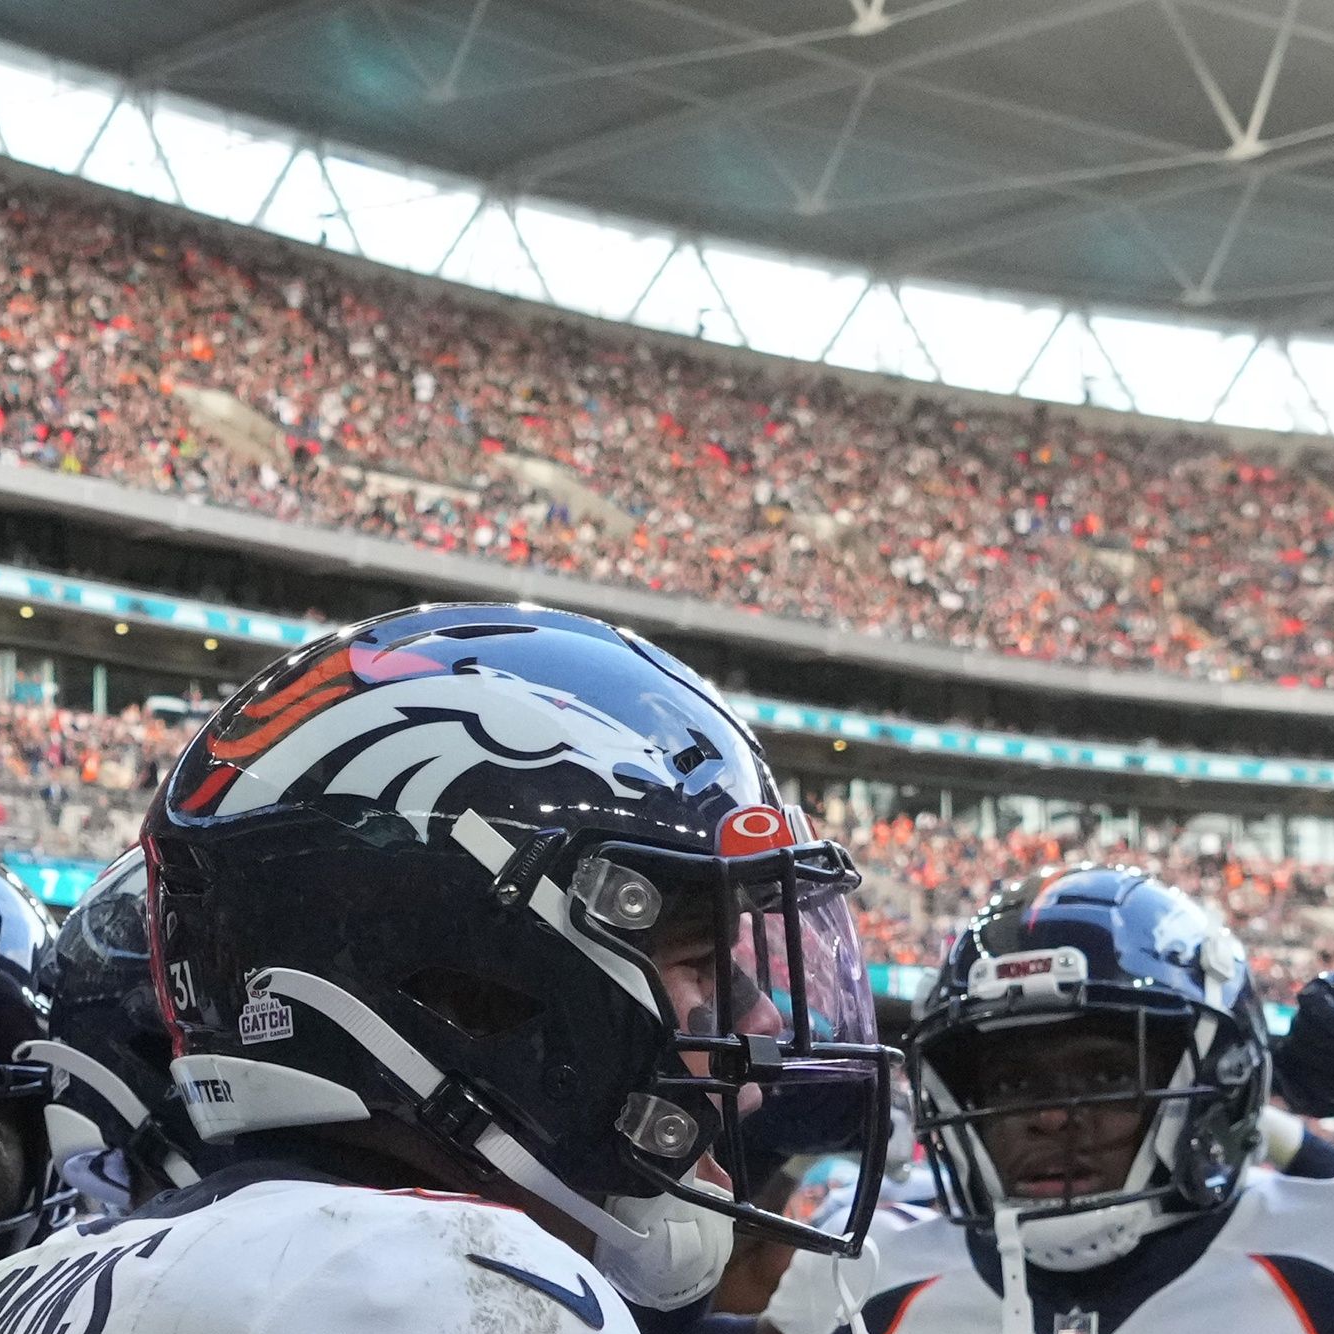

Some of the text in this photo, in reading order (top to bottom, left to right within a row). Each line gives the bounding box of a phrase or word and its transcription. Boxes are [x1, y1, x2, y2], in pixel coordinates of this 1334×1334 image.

[169, 960, 197, 1011] 31
[244, 1002, 281, 1015] CRUCIAL
[240, 1009, 291, 1035] CATCH
